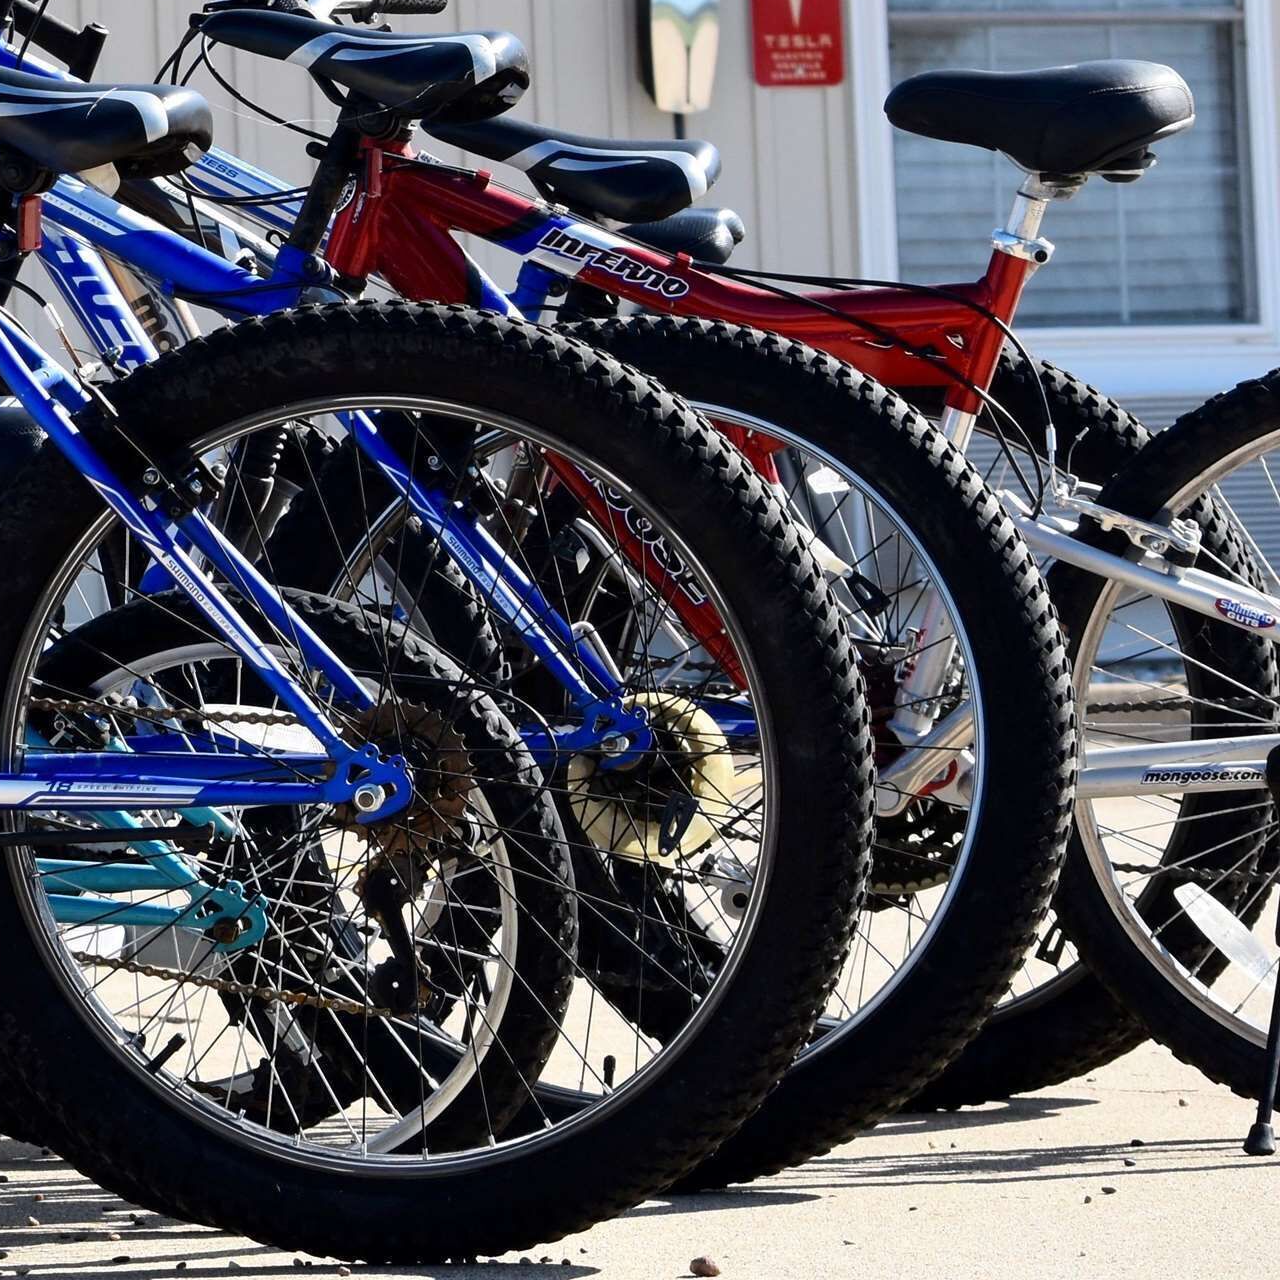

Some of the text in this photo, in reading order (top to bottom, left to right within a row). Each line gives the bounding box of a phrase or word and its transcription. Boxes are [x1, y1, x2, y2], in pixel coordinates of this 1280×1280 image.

[763, 33, 834, 49] TESLA
[447, 536, 481, 574] SHIMANO
[166, 559, 205, 603] SHIMANO
[1219, 599, 1274, 625] SHIMANO
[1226, 611, 1260, 627] GUTS
[1143, 769, 1265, 784] mongoose.com
[44, 779, 74, 793] 18
